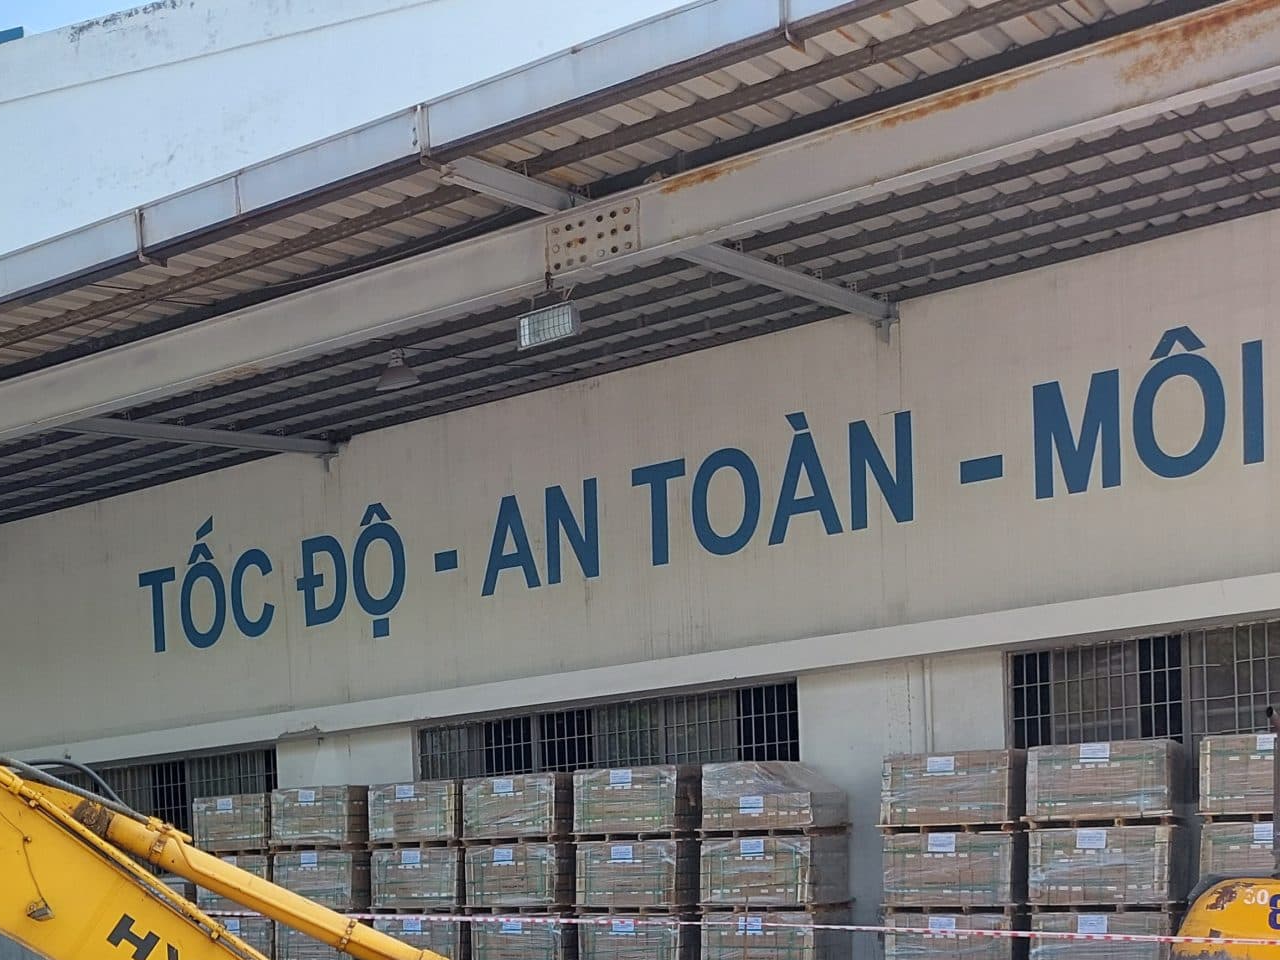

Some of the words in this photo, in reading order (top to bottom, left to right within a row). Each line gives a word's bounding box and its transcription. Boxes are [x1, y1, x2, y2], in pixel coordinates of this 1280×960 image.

[138, 515, 275, 652] TỐC
[296, 502, 406, 638] ĐỘ
[434, 550, 458, 572] -
[482, 476, 600, 596] AN
[631, 411, 915, 567] TOÀN
[960, 454, 1003, 484] -
[1032, 326, 1265, 499] MÔI
